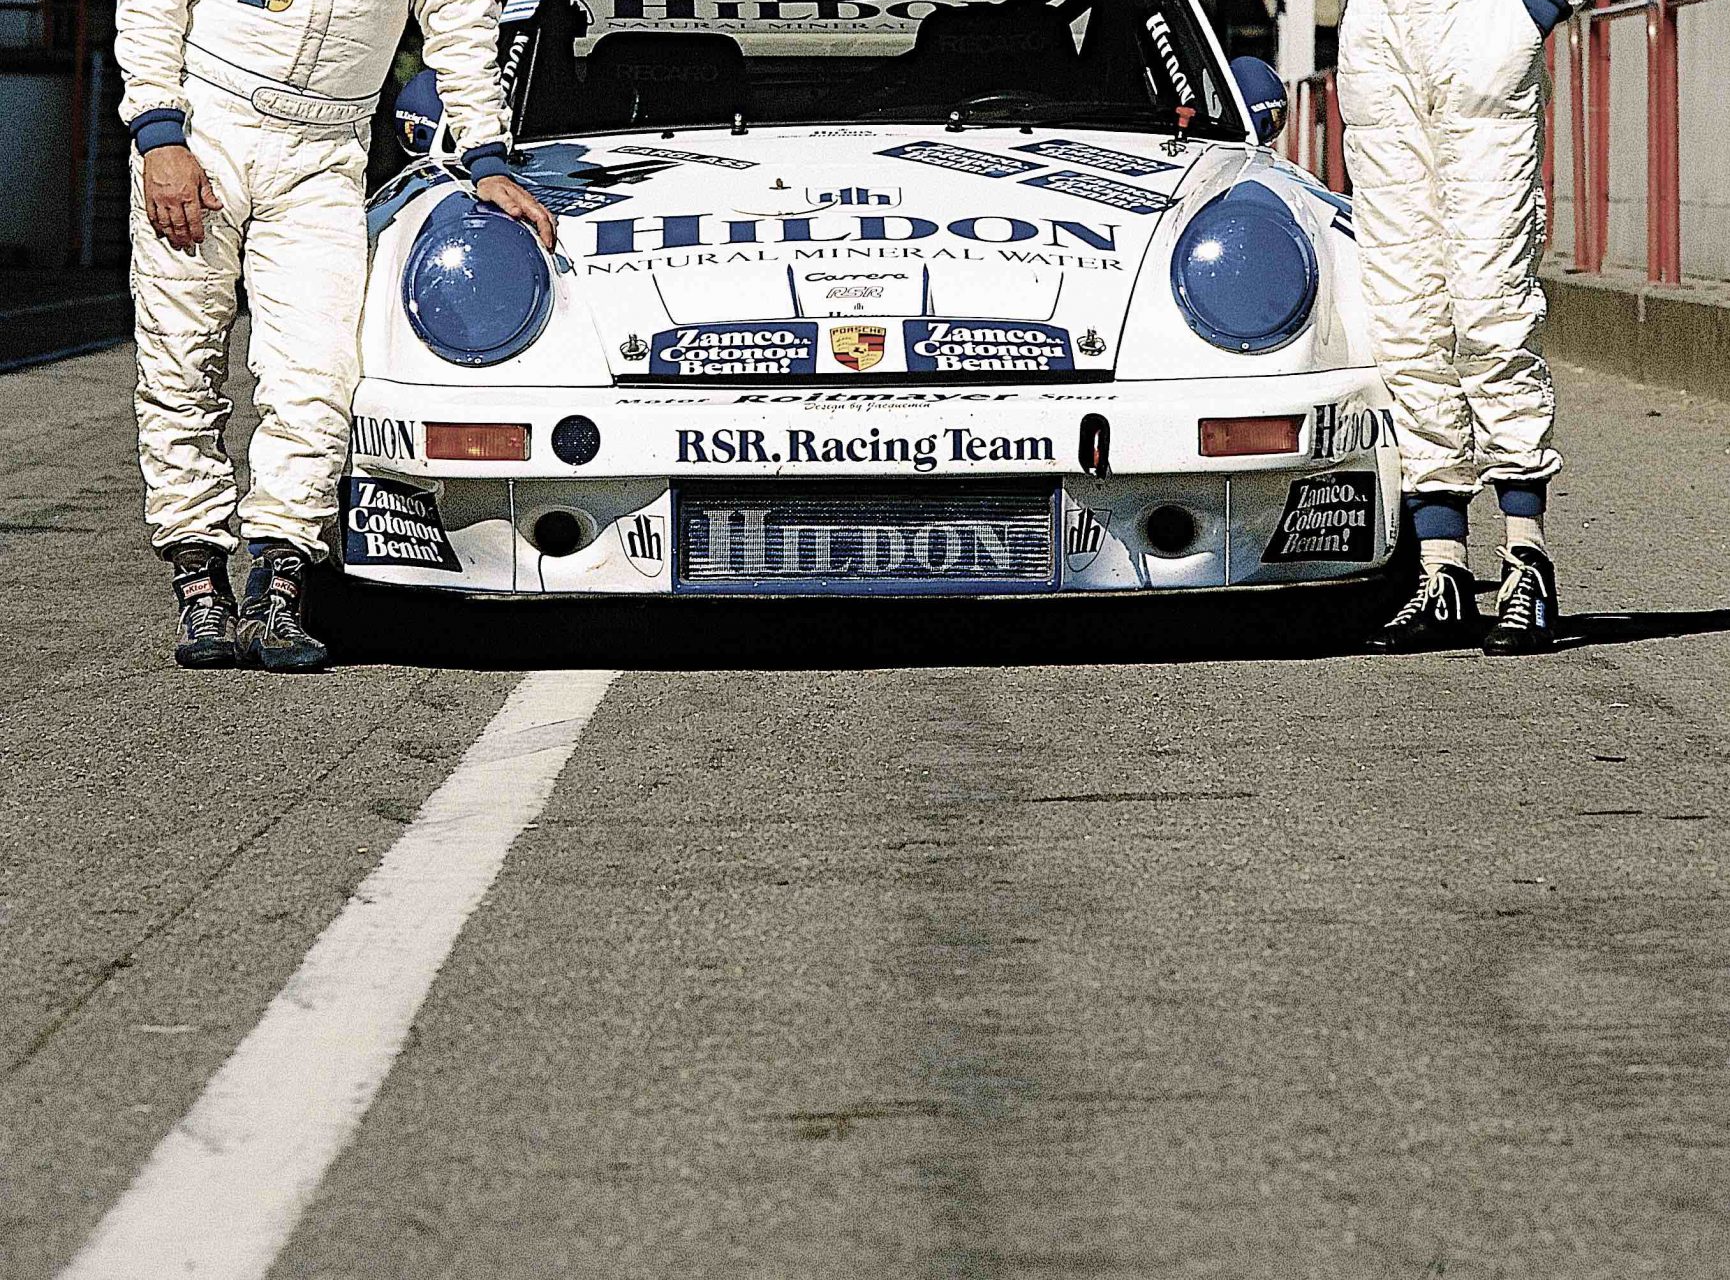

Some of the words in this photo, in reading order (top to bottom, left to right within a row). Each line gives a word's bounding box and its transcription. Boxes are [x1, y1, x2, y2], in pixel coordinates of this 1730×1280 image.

[1146, 12, 1195, 105] HILDON
[618, 146, 749, 169] CARGLASS
[584, 214, 1122, 257] HILDON
[588, 250, 779, 275] NATURAL
[795, 247, 984, 260] MINERAL
[998, 249, 1124, 271] WATER
[805, 272, 909, 282] Carrera
[826, 286, 884, 298] RSR
[676, 329, 795, 347] Zamco
[832, 325, 883, 335] PORSCHE
[928, 322, 1047, 344] Zamco
[660, 347, 809, 361] Cotonou
[914, 340, 1065, 357] Cotonou
[678, 357, 791, 375] Benin!
[935, 354, 1050, 371] Benin!
[733, 392, 1018, 403] Roitmayer
[1039, 393, 1118, 401] Sport
[804, 402, 846, 413] Design
[848, 402, 862, 412] by
[351, 415, 416, 460] ILDON
[675, 428, 782, 464] RSR.
[787, 427, 938, 471] Racing
[944, 428, 1054, 462] Team
[359, 482, 426, 517] Zamco
[1298, 483, 1354, 510] Zamco
[348, 508, 443, 543] Cotonou
[1284, 508, 1367, 532] Cotonou
[364, 532, 443, 563] Benin!
[701, 509, 1013, 573] HILDON
[1281, 528, 1350, 554] Benin!
